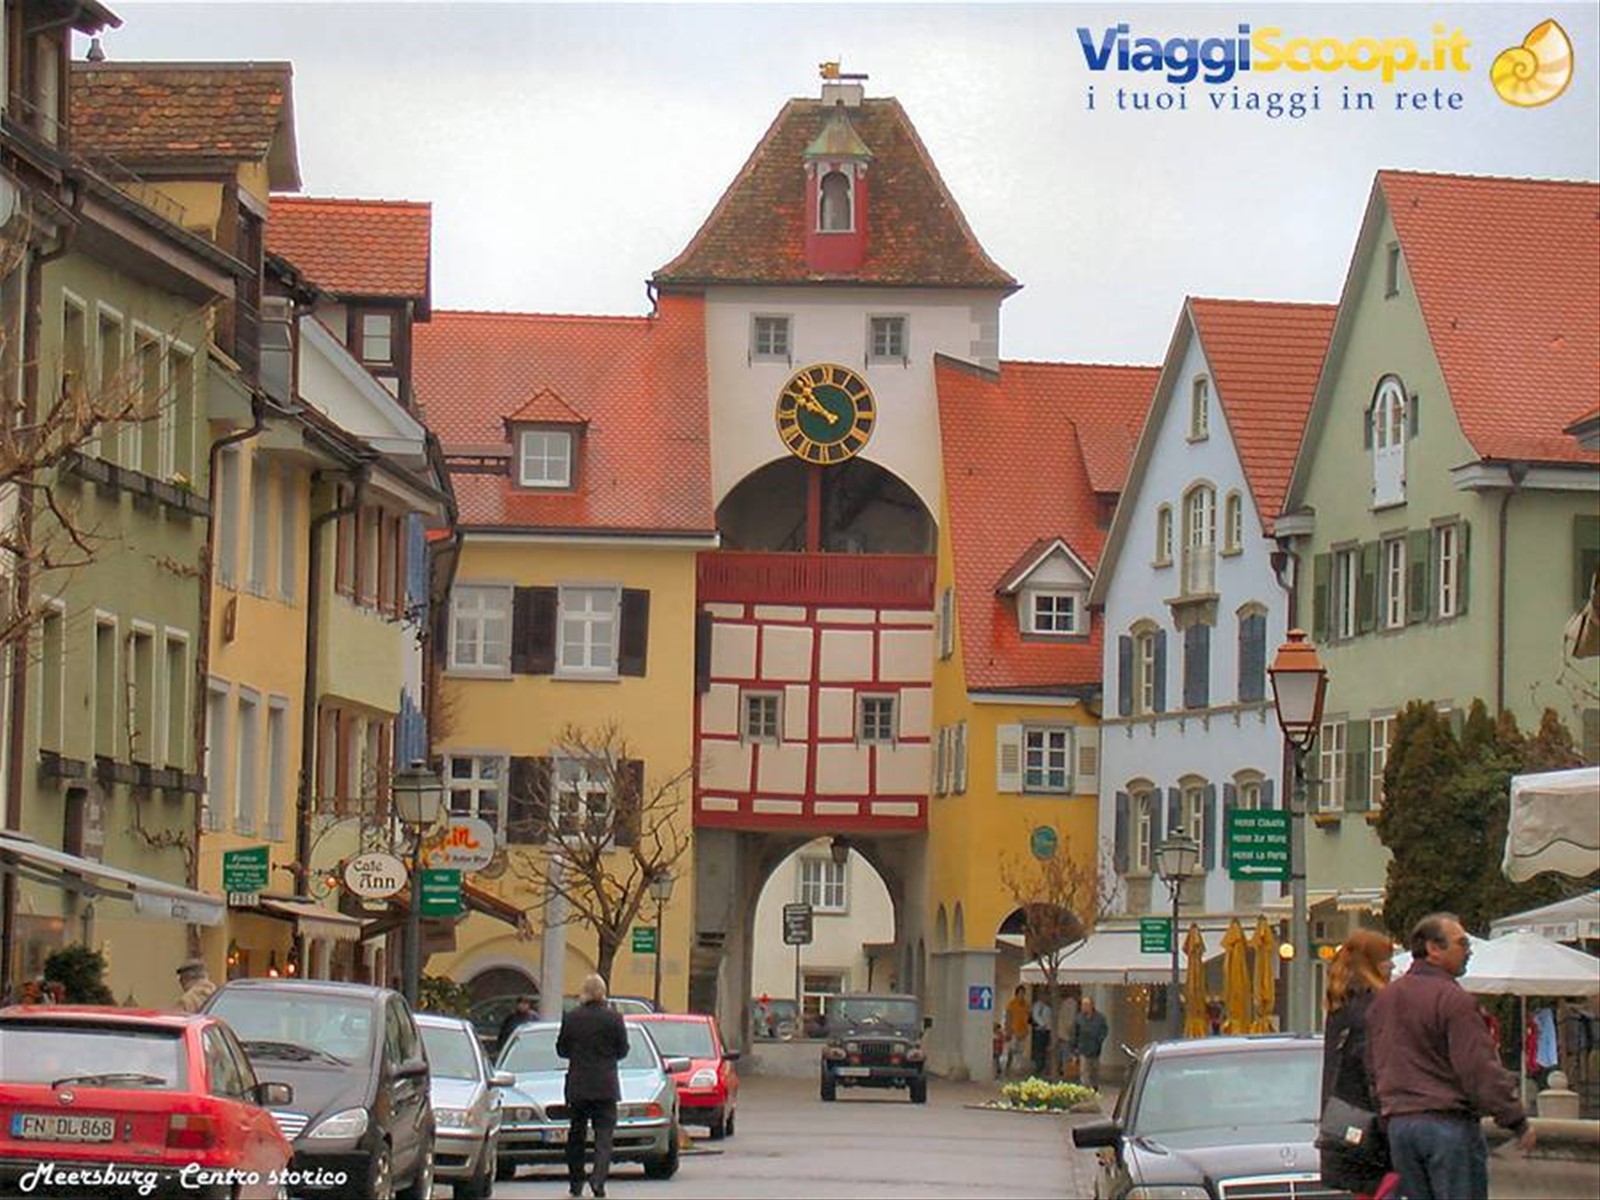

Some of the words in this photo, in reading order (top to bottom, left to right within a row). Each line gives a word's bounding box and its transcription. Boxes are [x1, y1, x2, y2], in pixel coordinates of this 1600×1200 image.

[360, 873, 396, 889] Ann
[22, 1116, 46, 1134] FN
[56, 1118, 78, 1135] DL
[79, 1119, 113, 1137] 868
